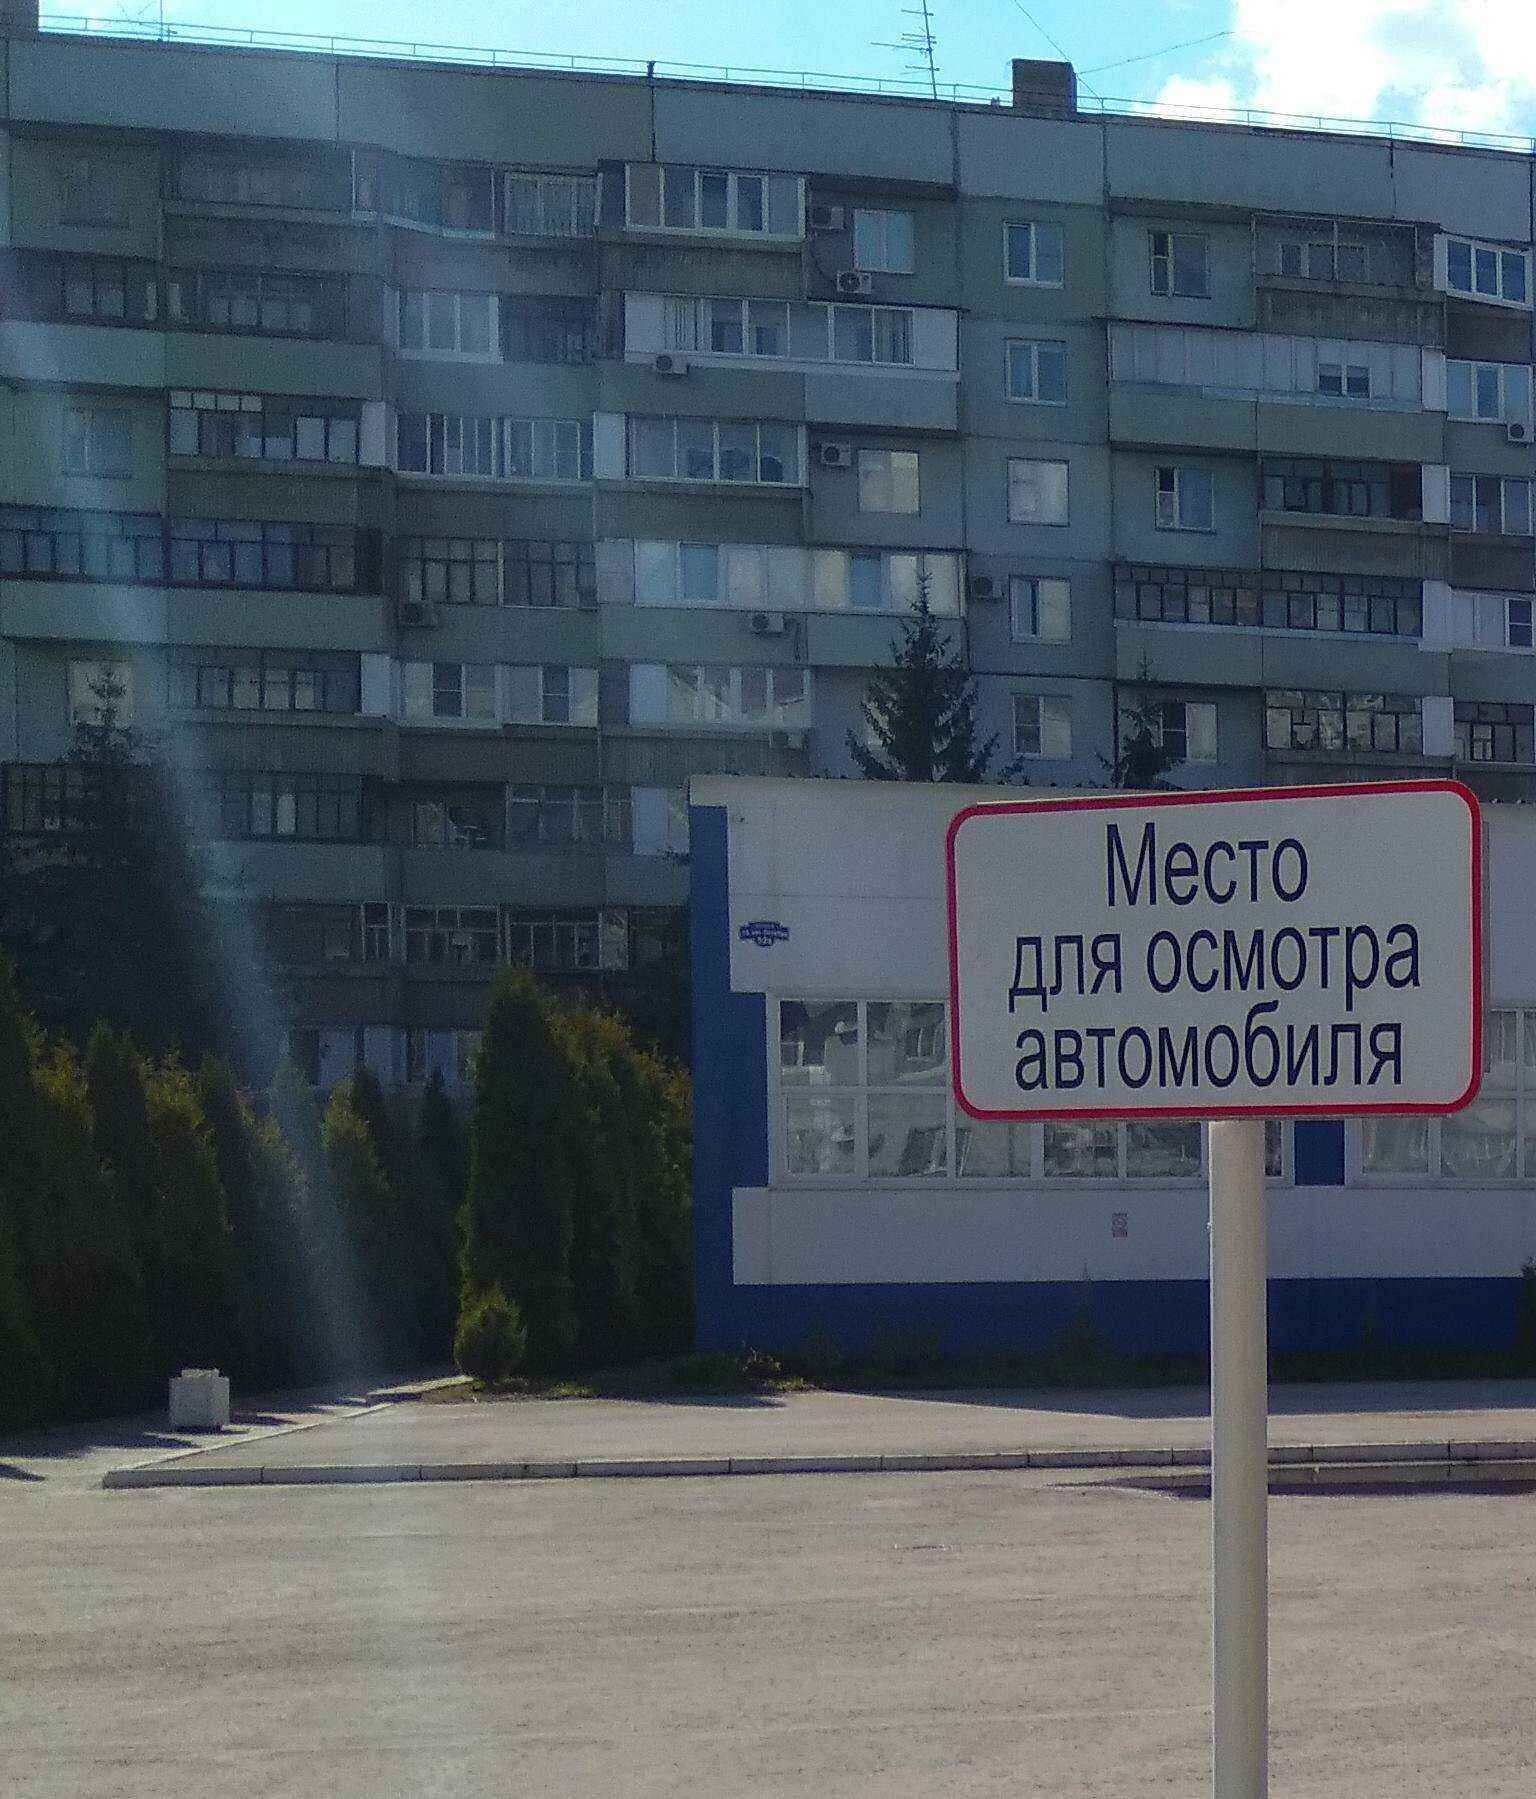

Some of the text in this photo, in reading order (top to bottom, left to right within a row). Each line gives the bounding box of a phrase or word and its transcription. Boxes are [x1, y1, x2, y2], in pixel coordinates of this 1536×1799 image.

[1106, 822, 1309, 907] Место
[1008, 922, 1421, 1013] для осмотра
[1014, 1000, 1402, 1090] автомобиля
